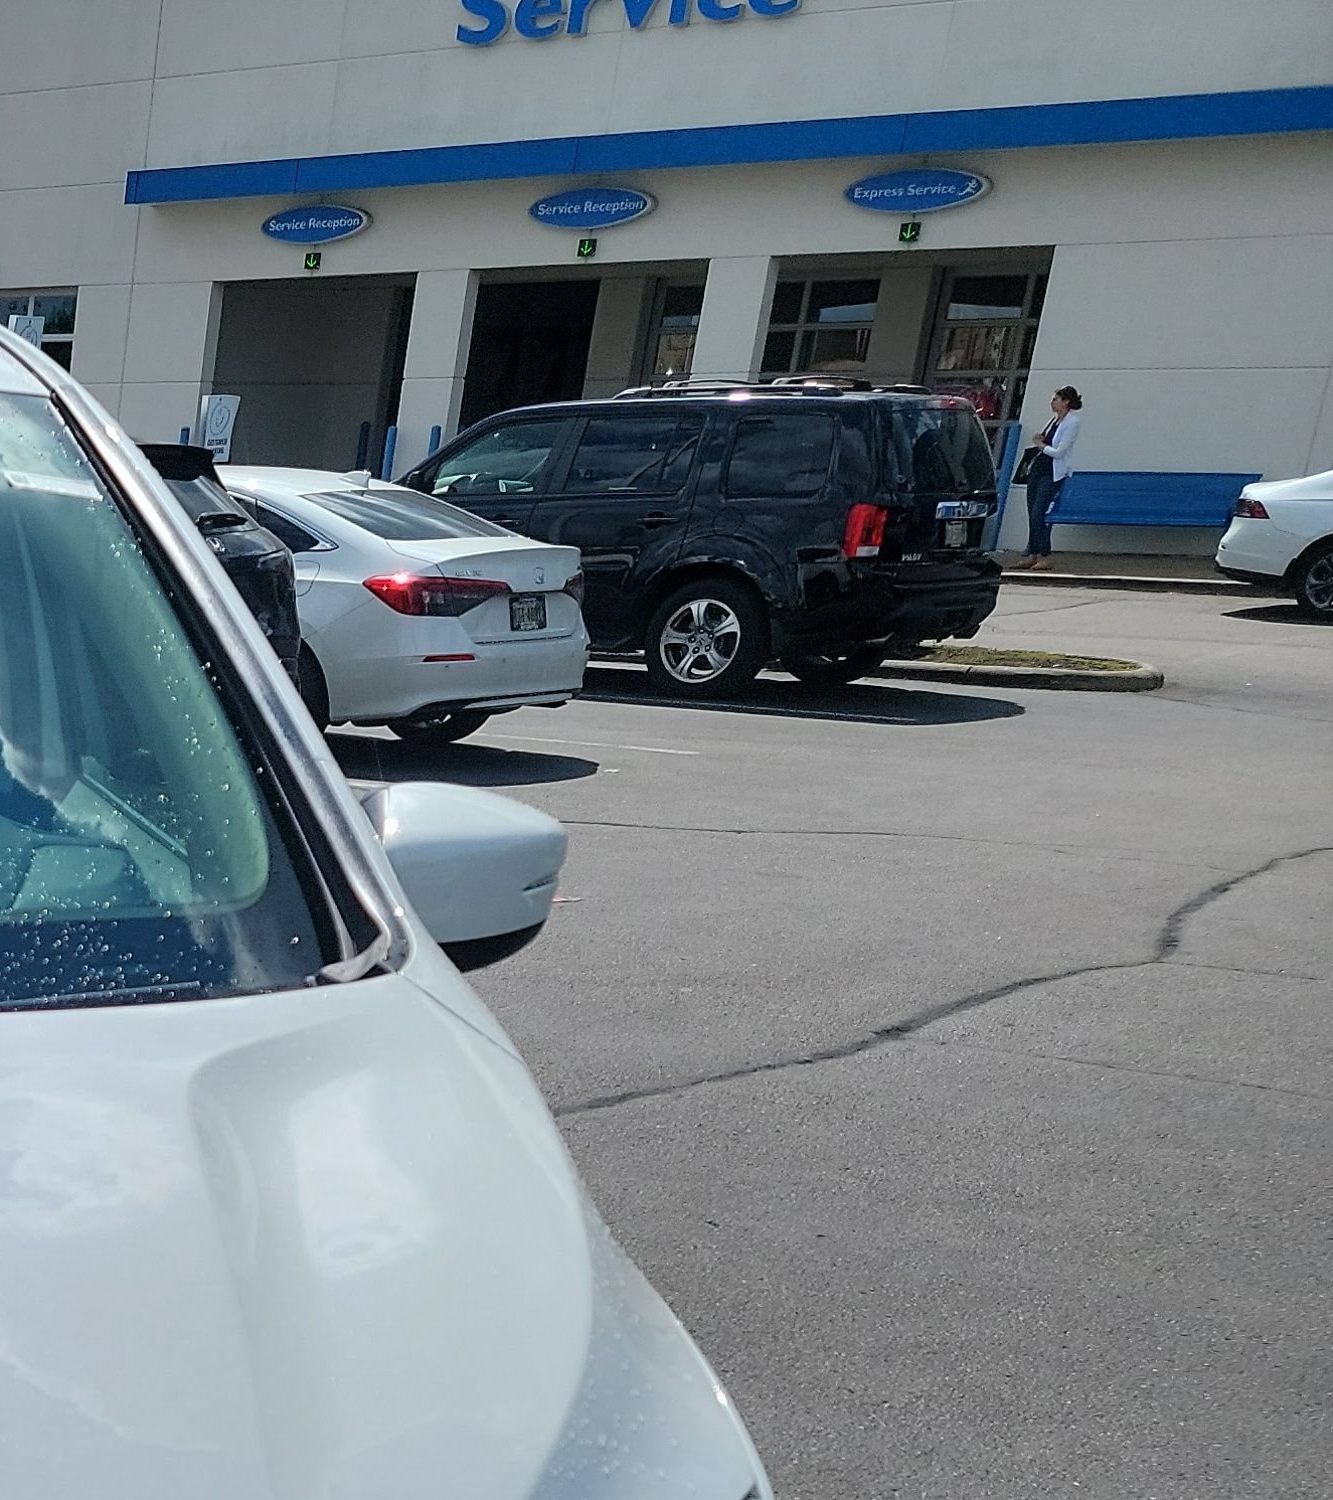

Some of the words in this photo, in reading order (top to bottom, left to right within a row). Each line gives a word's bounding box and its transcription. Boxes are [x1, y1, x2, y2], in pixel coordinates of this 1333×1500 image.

[853, 187, 903, 200] Express
[906, 183, 956, 196] Service
[537, 202, 582, 216] Service
[583, 198, 644, 214] Reception
[269, 219, 306, 232] Service
[308, 215, 360, 231] Reception
